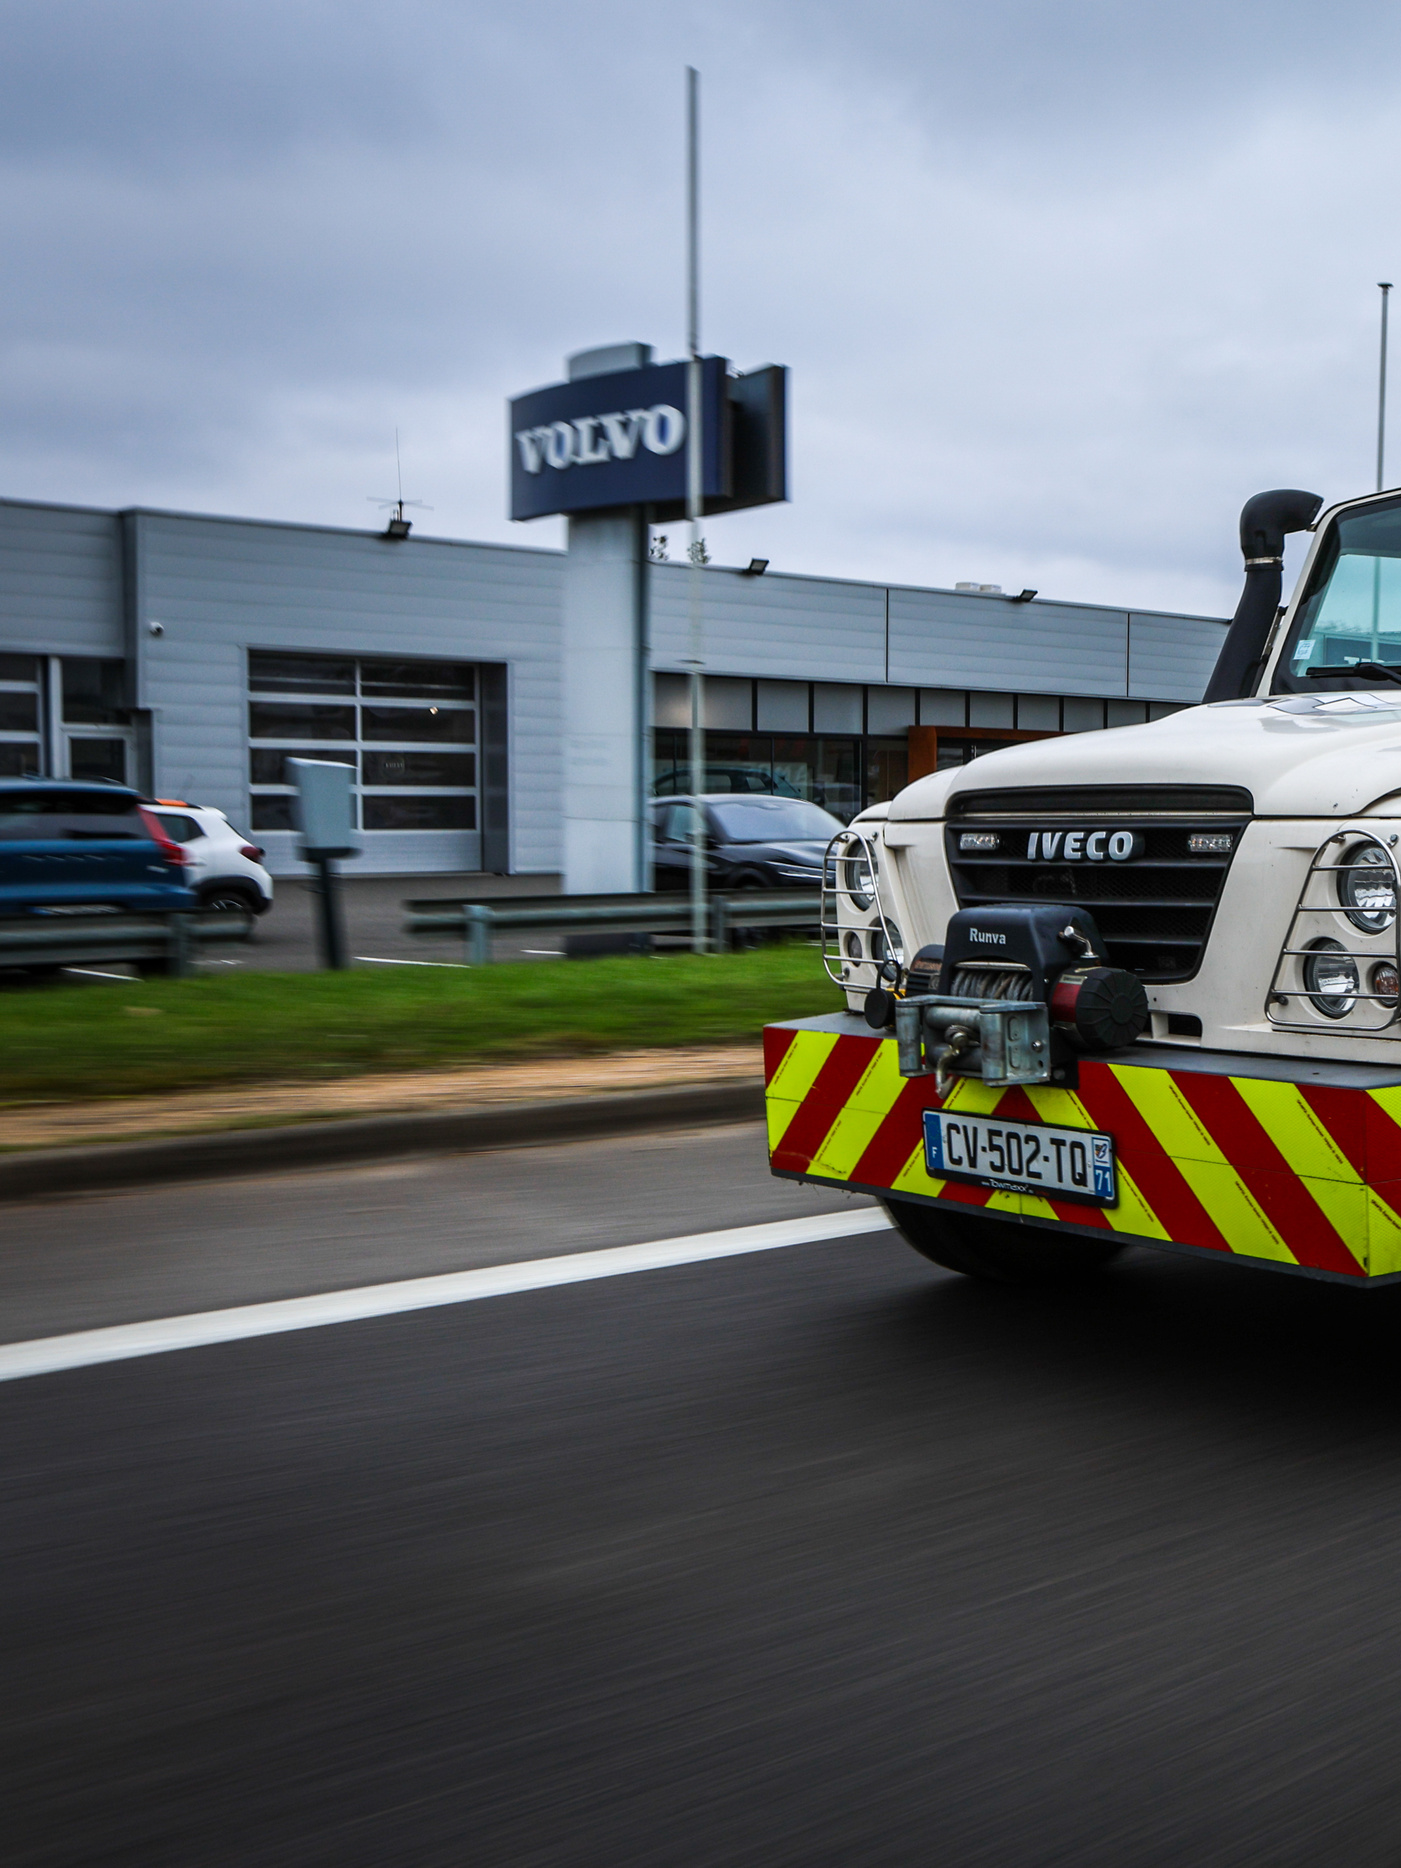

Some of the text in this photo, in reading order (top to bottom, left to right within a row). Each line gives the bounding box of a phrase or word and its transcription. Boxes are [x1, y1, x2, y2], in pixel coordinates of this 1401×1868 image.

[514, 403, 687, 475] VOLVO
[1027, 831, 1135, 861] IVECO
[969, 927, 1007, 945] Runva
[932, 1146, 938, 1159] F
[946, 1121, 1088, 1188] CV-502-TQ
[1095, 1170, 1113, 1193] 71
